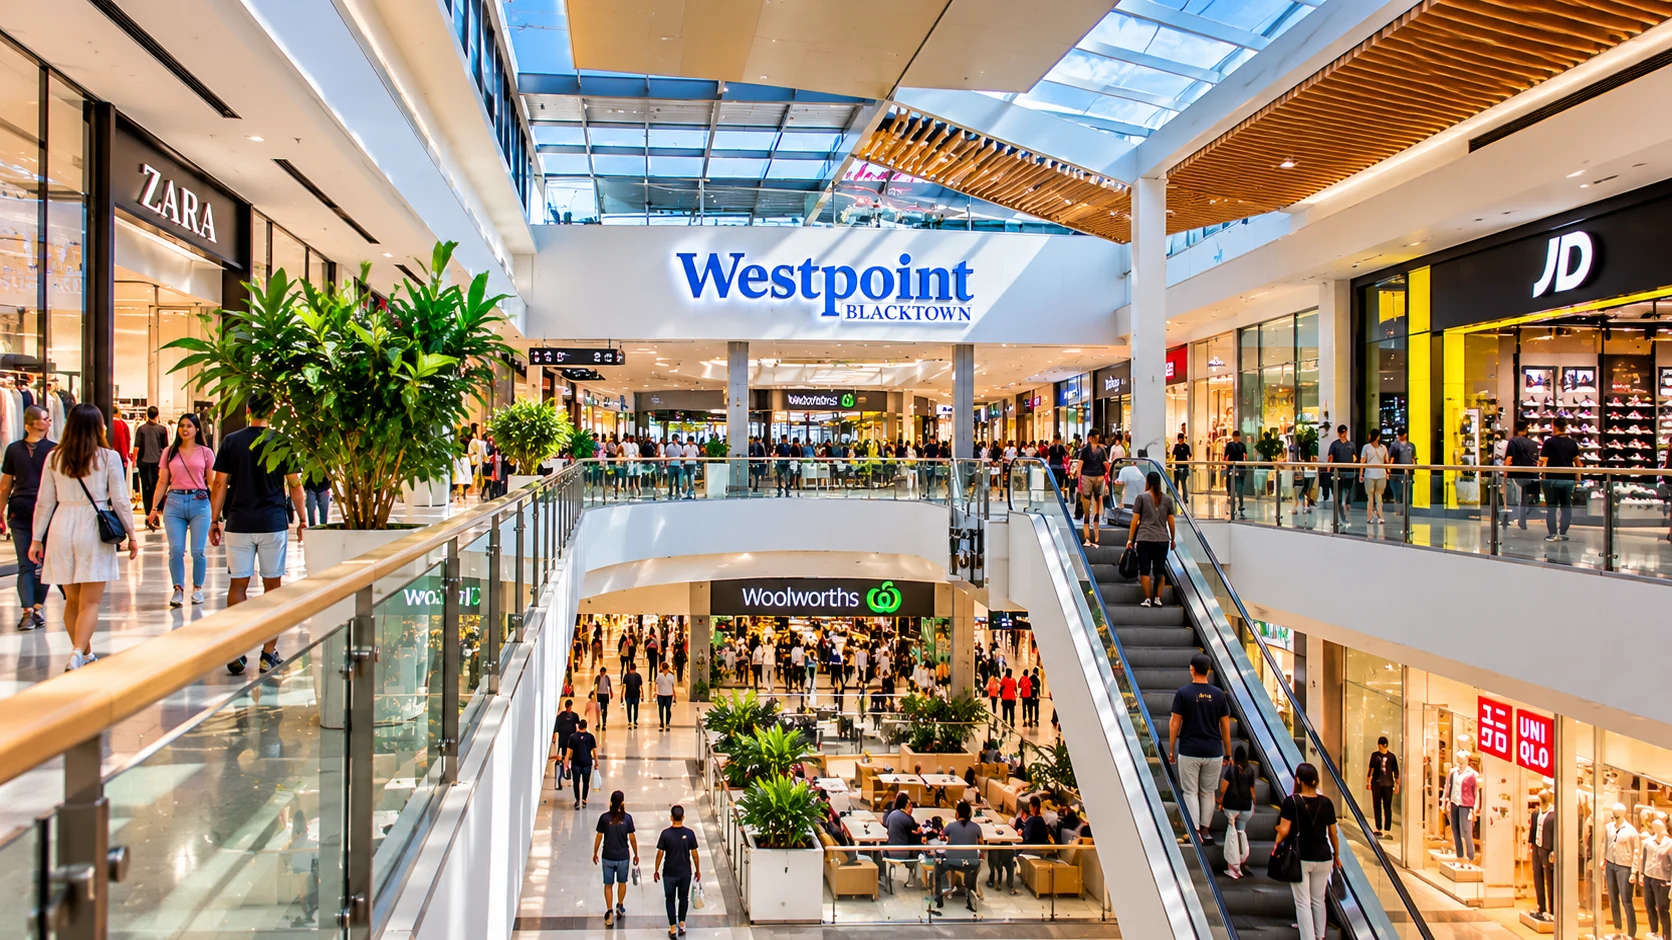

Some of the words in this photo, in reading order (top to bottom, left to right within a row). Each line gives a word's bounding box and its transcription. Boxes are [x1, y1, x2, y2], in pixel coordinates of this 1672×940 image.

[139, 163, 218, 243] ZARA
[1532, 230, 1593, 298] JD
[676, 252, 974, 316] Westpoint
[845, 304, 972, 321] BLACKTOWN
[742, 586, 859, 608] Woolworths
[1519, 716, 1546, 745] UNI
[1519, 740, 1549, 769] QLO
